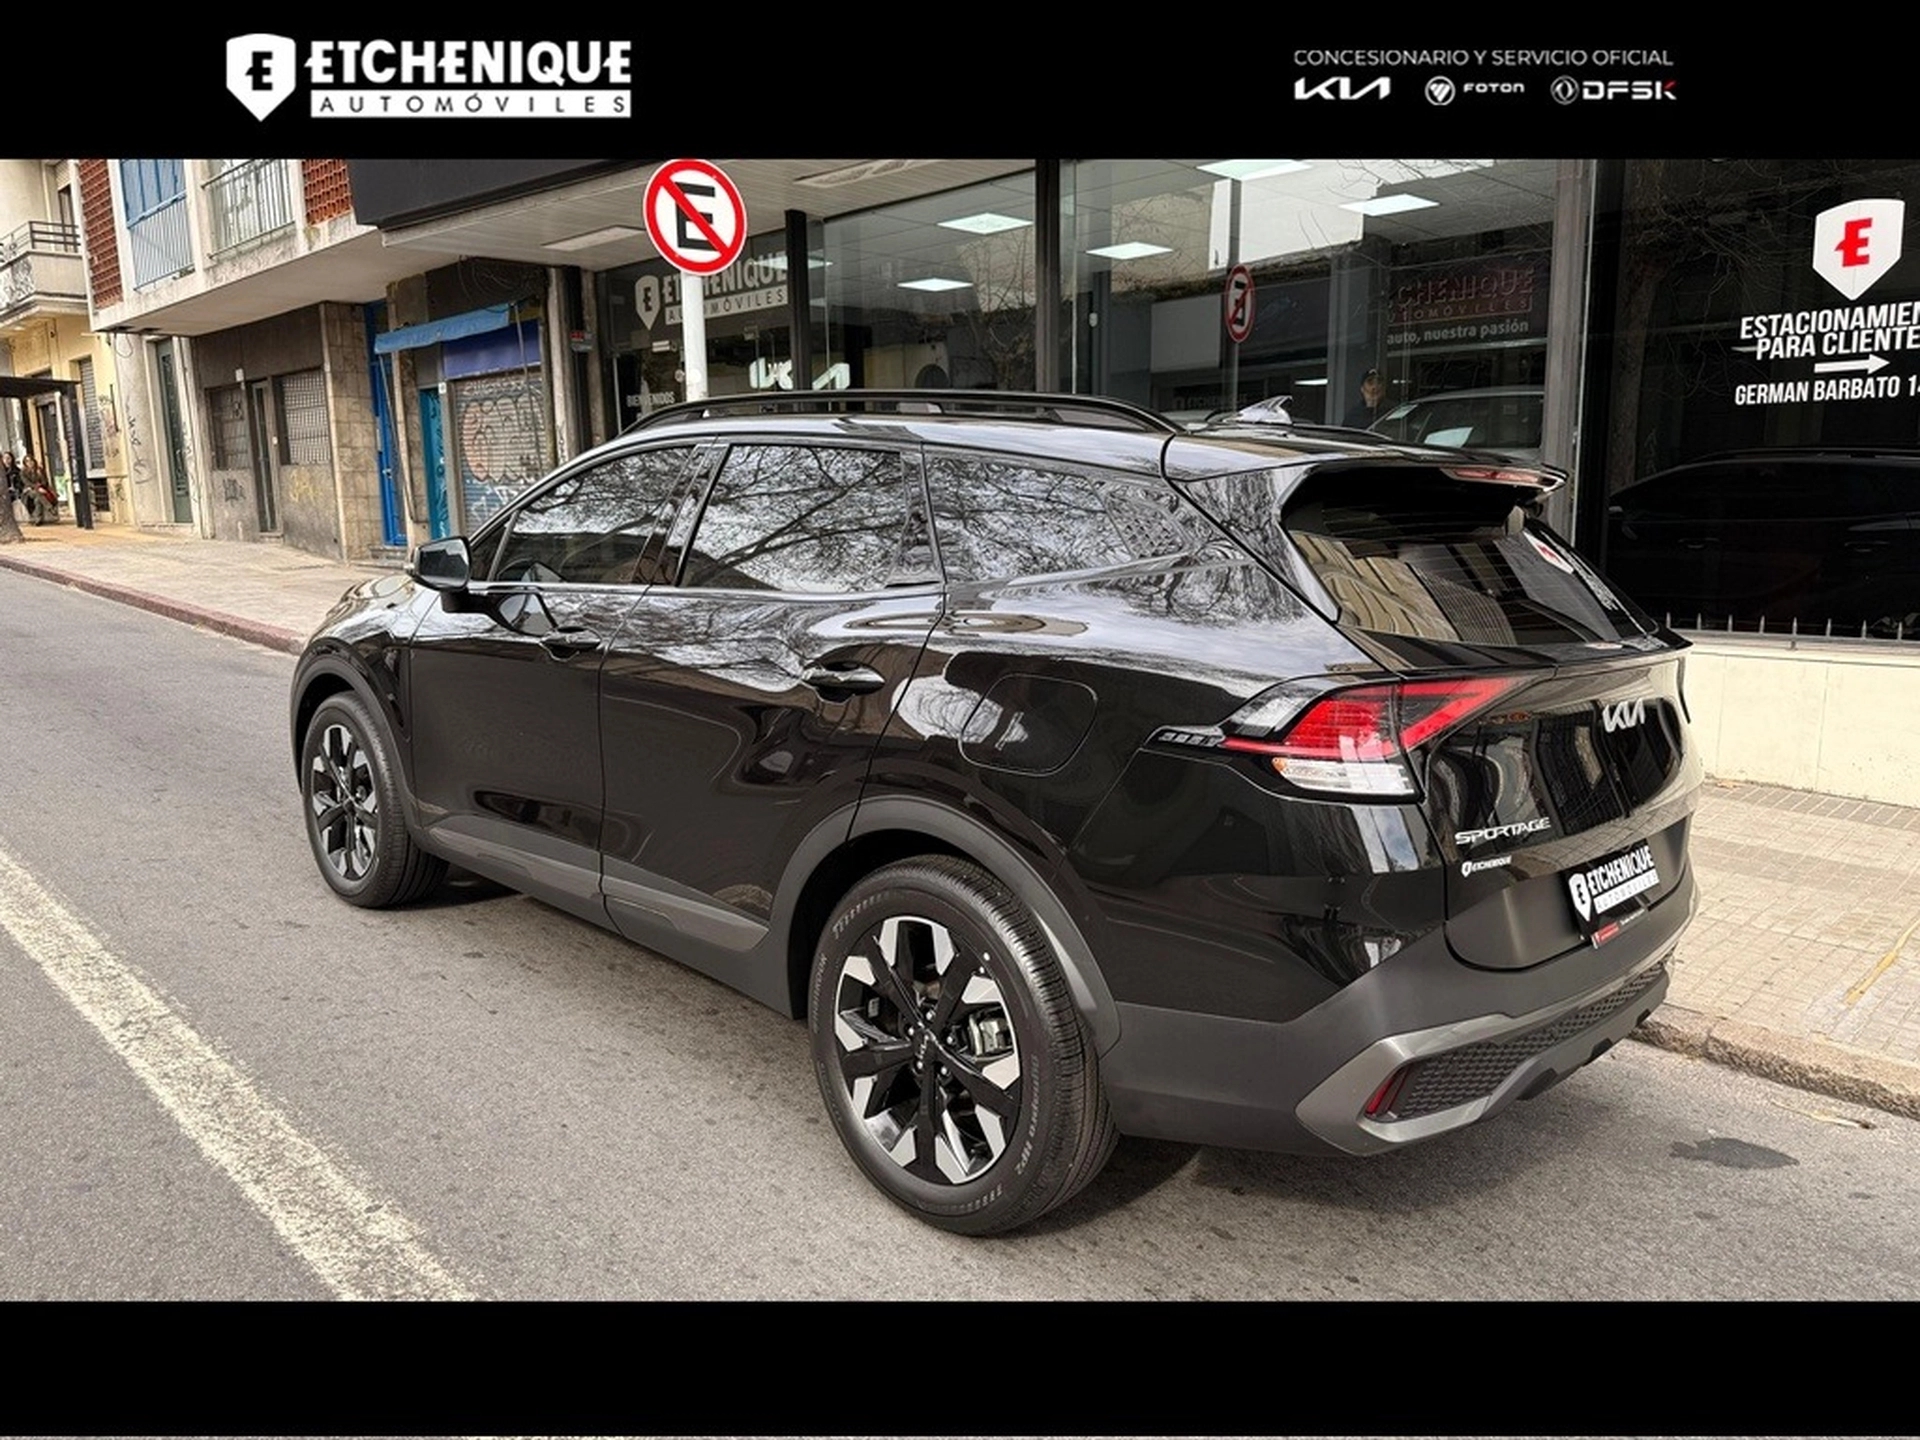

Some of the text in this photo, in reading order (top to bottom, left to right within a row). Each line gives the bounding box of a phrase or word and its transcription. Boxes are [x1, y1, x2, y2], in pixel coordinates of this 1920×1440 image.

[1424, 325, 1477, 342] nuestra
[1480, 318, 1529, 339] pasión
[1756, 334, 1816, 360] PARA
[1735, 382, 1809, 406] GERMAN
[1813, 375, 1901, 401] BARBATO
[1454, 817, 1551, 845] SPORTAGE
[1586, 845, 1655, 896] ETCHENIQUE
